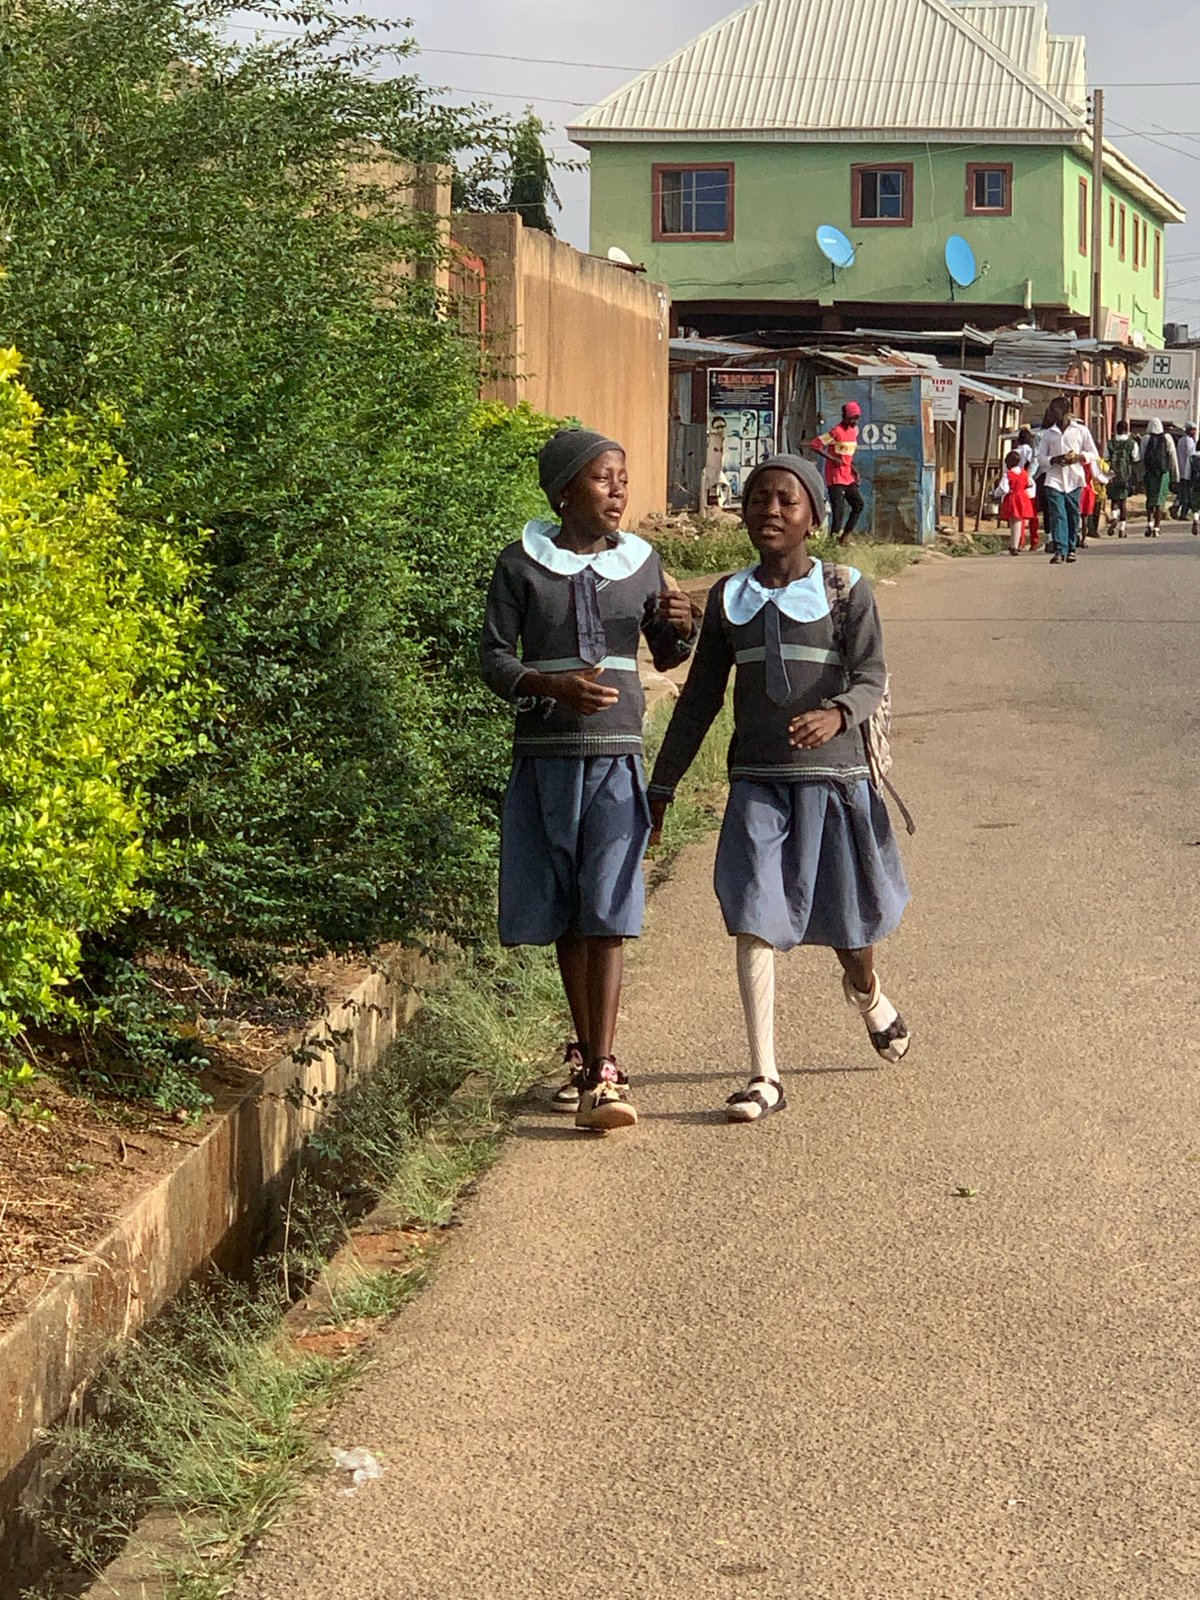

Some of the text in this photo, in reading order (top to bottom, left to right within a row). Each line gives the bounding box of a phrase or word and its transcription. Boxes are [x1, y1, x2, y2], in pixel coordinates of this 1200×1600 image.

[1128, 378, 1190, 390] DADINKOWA
[1127, 399, 1190, 410] PHARMACY
[861, 423, 897, 444] OS
